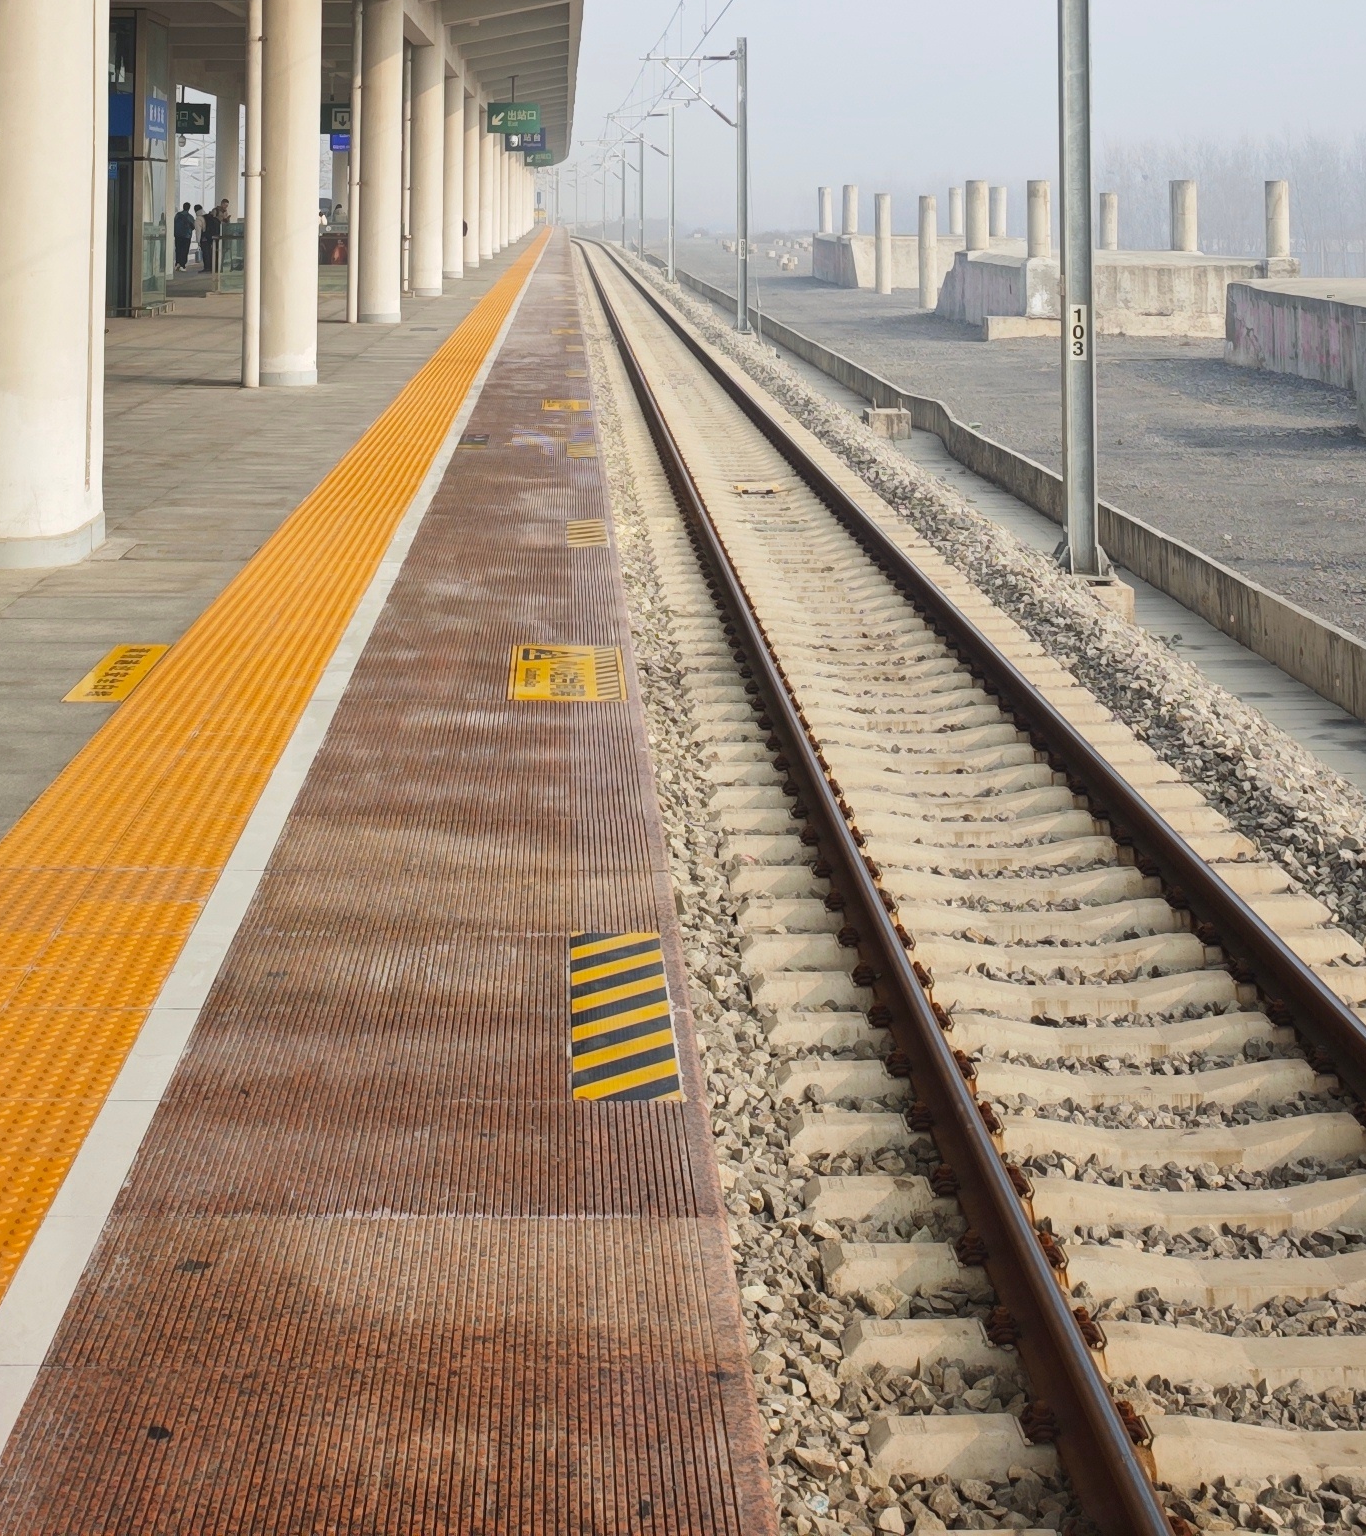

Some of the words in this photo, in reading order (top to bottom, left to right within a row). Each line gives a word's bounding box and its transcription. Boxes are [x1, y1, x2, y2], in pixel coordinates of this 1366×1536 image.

[507, 109, 537, 121] 出站口
[1072, 308, 1084, 356] 103
